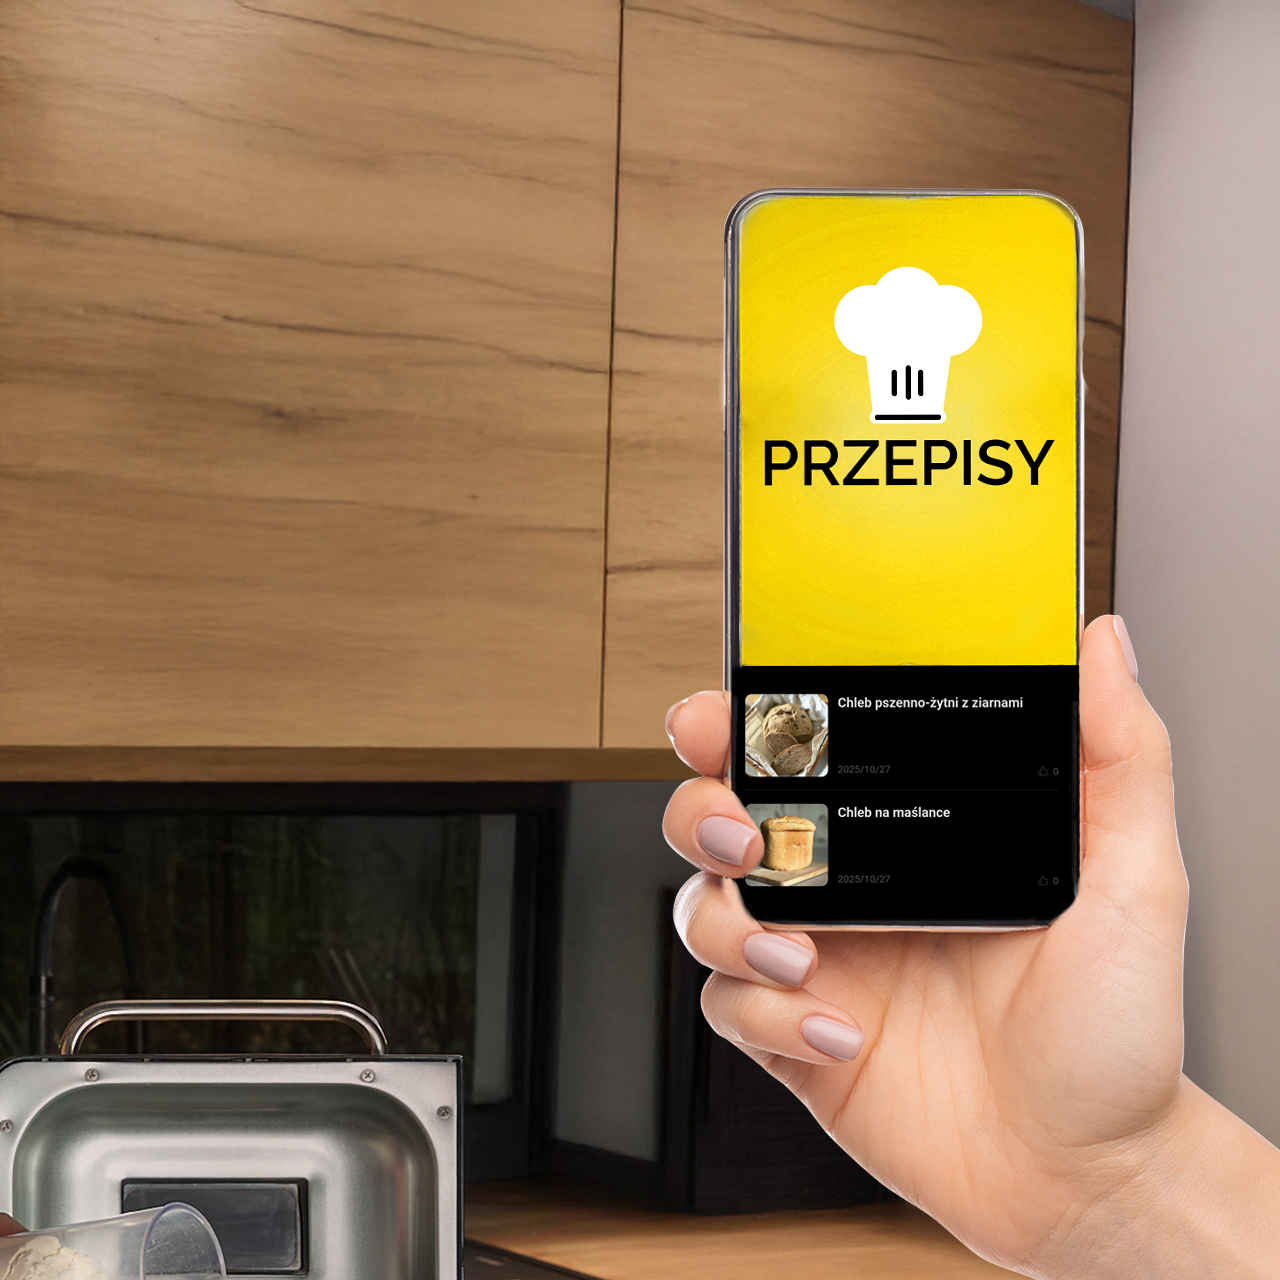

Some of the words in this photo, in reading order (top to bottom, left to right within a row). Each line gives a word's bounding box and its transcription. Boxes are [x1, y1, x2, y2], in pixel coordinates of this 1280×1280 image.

[765, 440, 1054, 485] PRZEPISY
[837, 696, 872, 709] Chleb
[875, 696, 958, 711] pszenno-żytni
[961, 699, 969, 709] z
[971, 696, 1024, 709] ziarnami
[837, 764, 891, 775] 2025/10/27
[837, 806, 872, 818] Chleb
[875, 809, 890, 818] na
[892, 805, 951, 818] maślance
[837, 874, 891, 885] 2025/10/27
